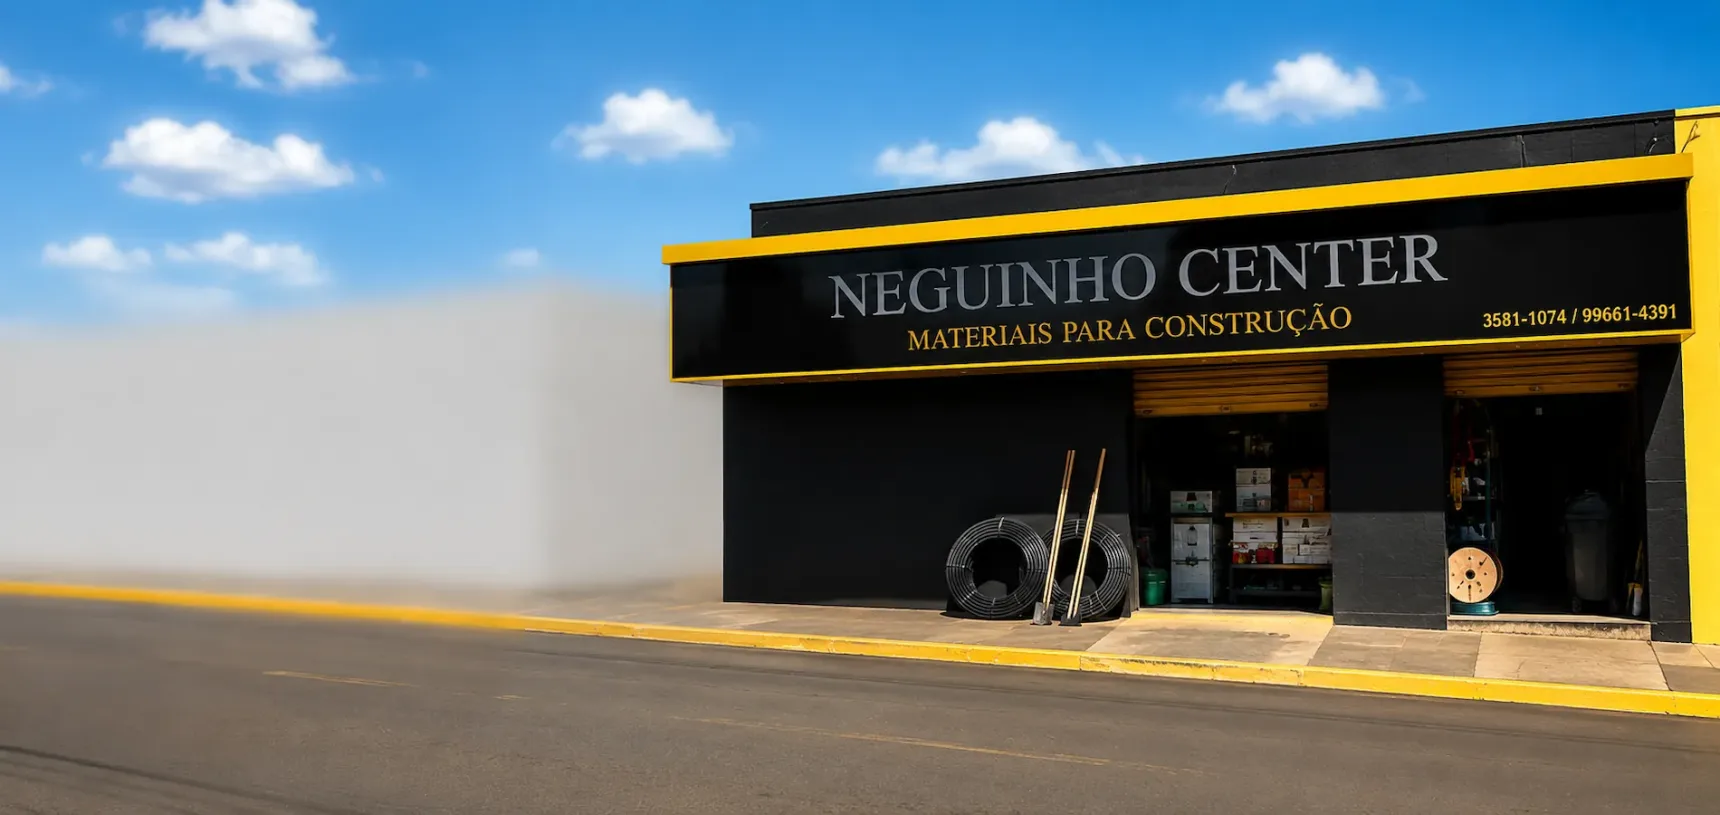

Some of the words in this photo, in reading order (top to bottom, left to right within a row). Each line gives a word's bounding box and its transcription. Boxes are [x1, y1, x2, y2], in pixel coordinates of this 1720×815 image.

[829, 252, 1156, 319] NEGUINHO
[1178, 234, 1449, 297] CENTER
[907, 325, 1053, 350] MATERIAIS
[1062, 319, 1137, 343] PARA
[1145, 303, 1352, 339] CONSTRUÇÃO
[1483, 308, 1568, 328] 3581-1074
[1571, 308, 1578, 325] /
[1581, 303, 1678, 323] 99661-4391
